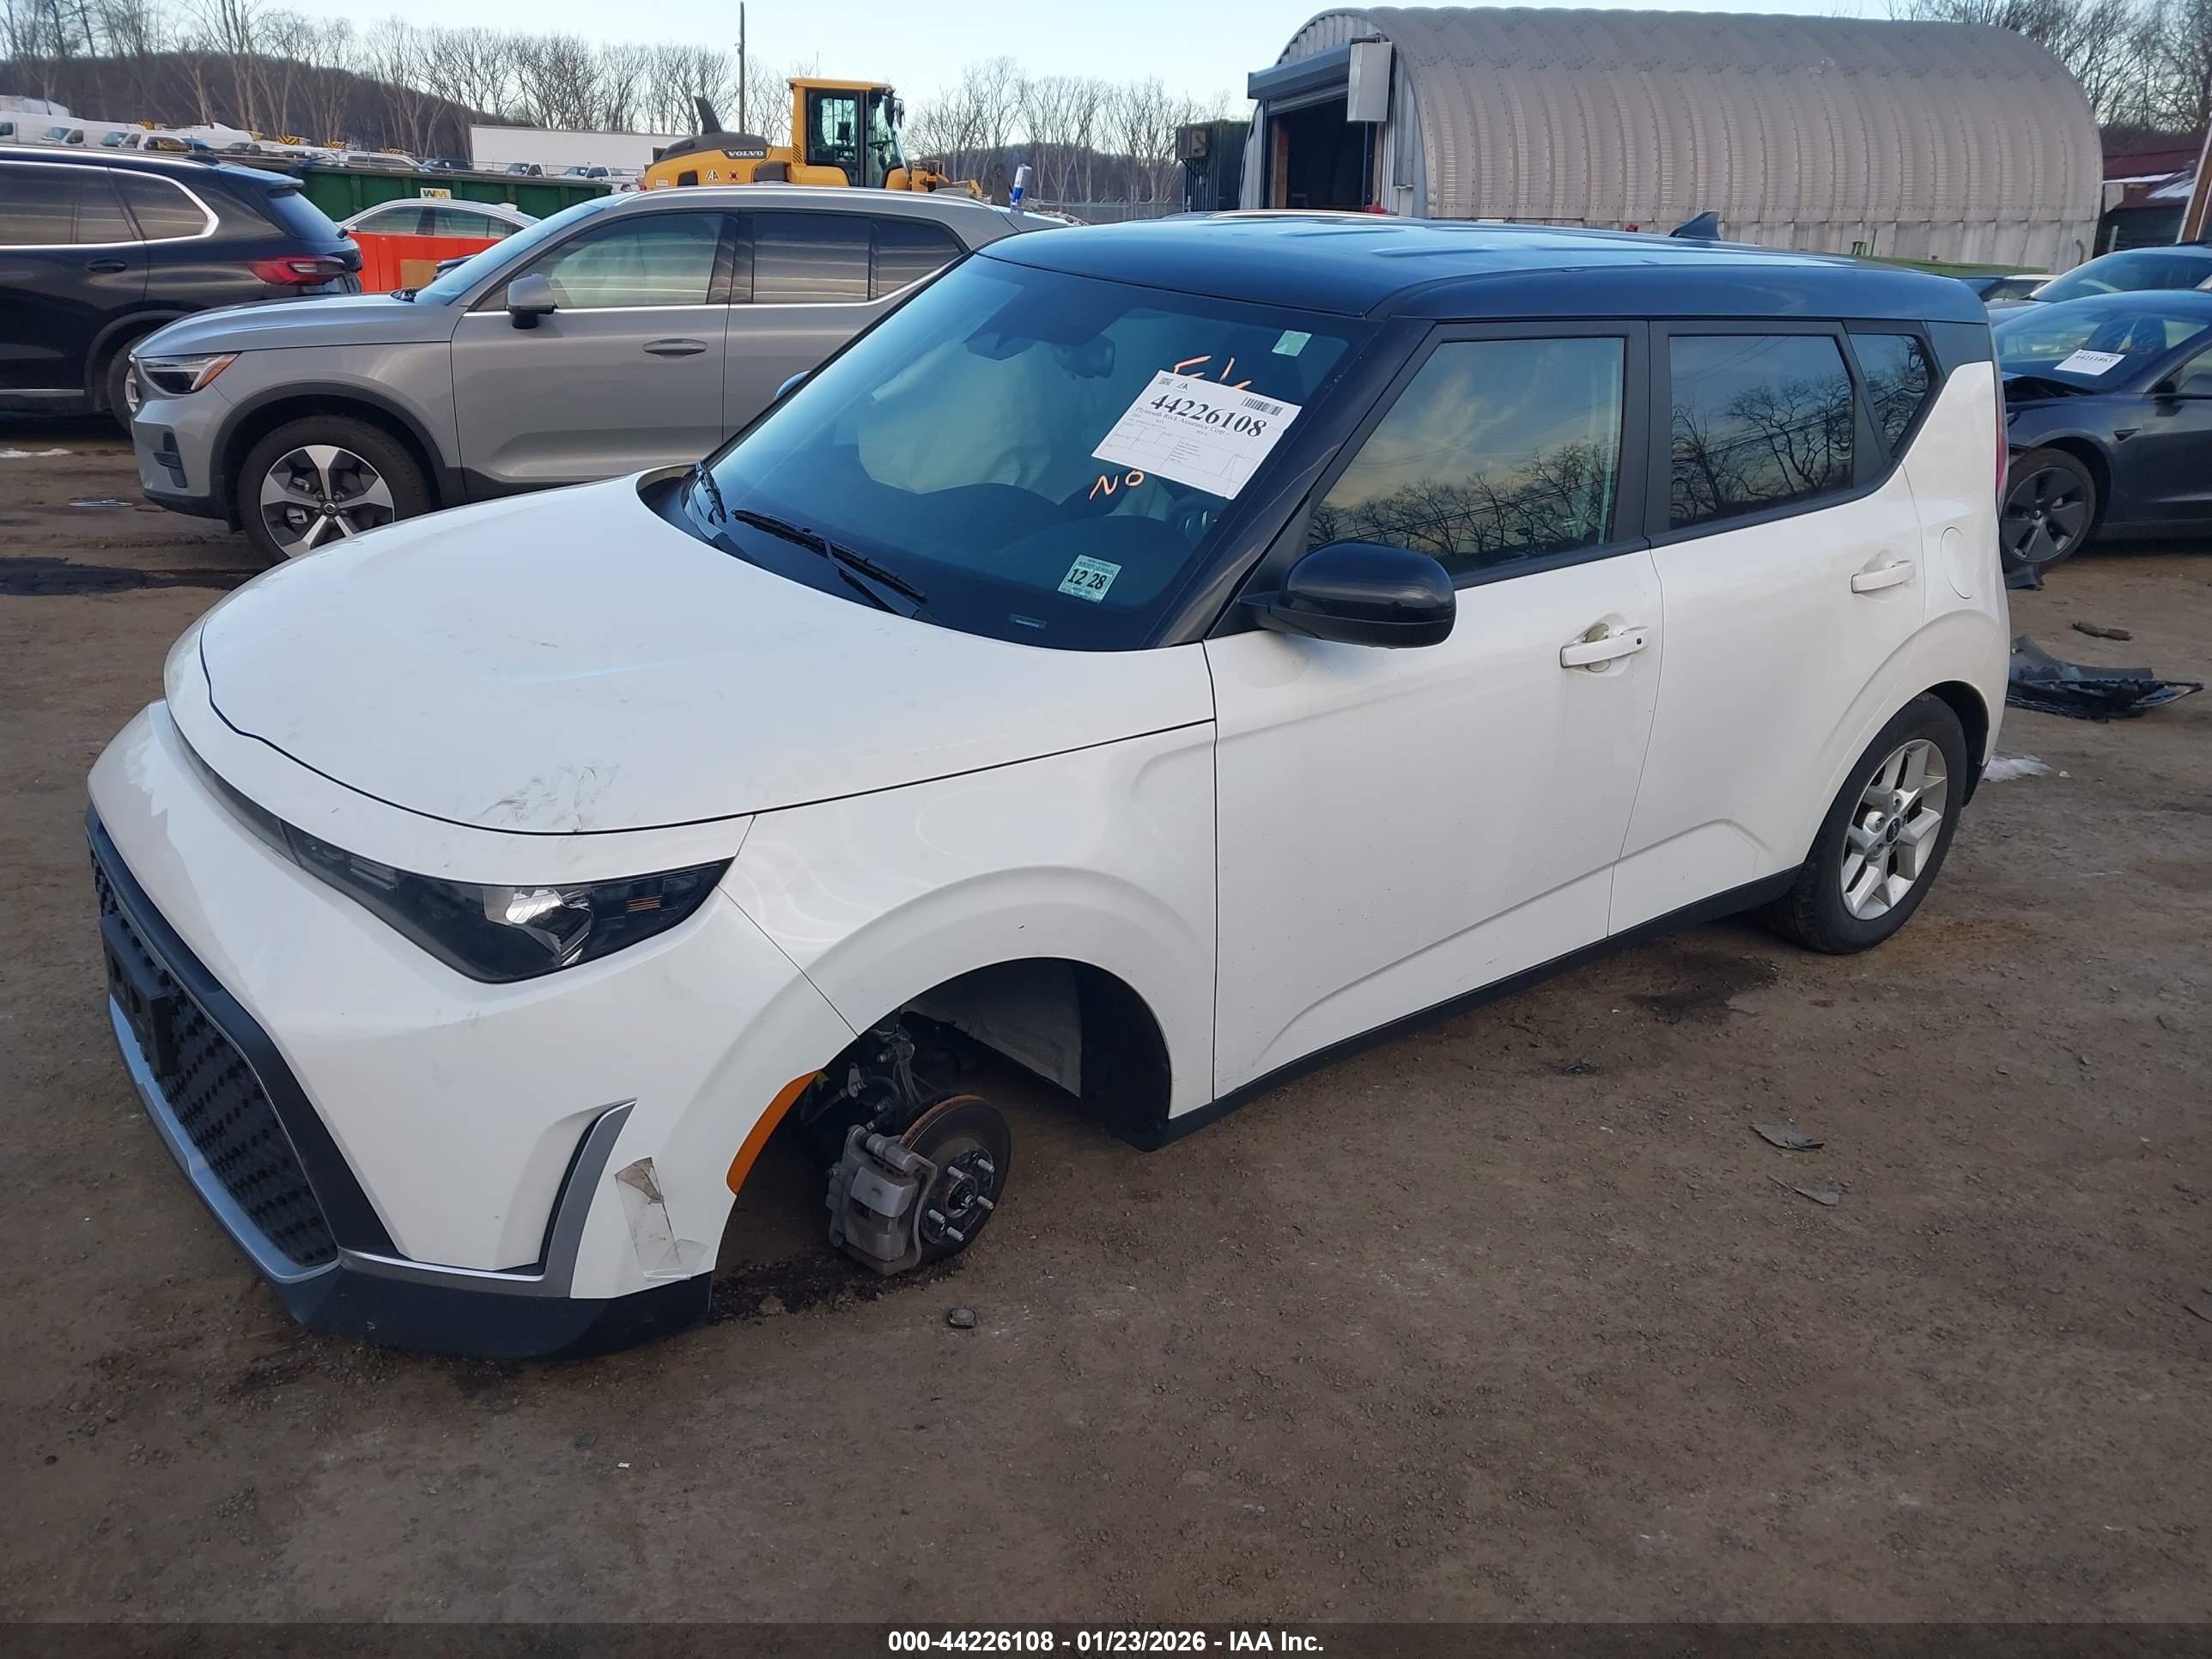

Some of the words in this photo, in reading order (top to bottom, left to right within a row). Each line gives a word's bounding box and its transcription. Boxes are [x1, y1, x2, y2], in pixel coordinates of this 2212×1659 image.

[422, 189, 447, 198] WM
[1150, 393, 1267, 438] 44226108
[1180, 418, 1209, 430] Assurance
[1066, 568, 1089, 586] 12
[1086, 572, 1108, 590] 28
